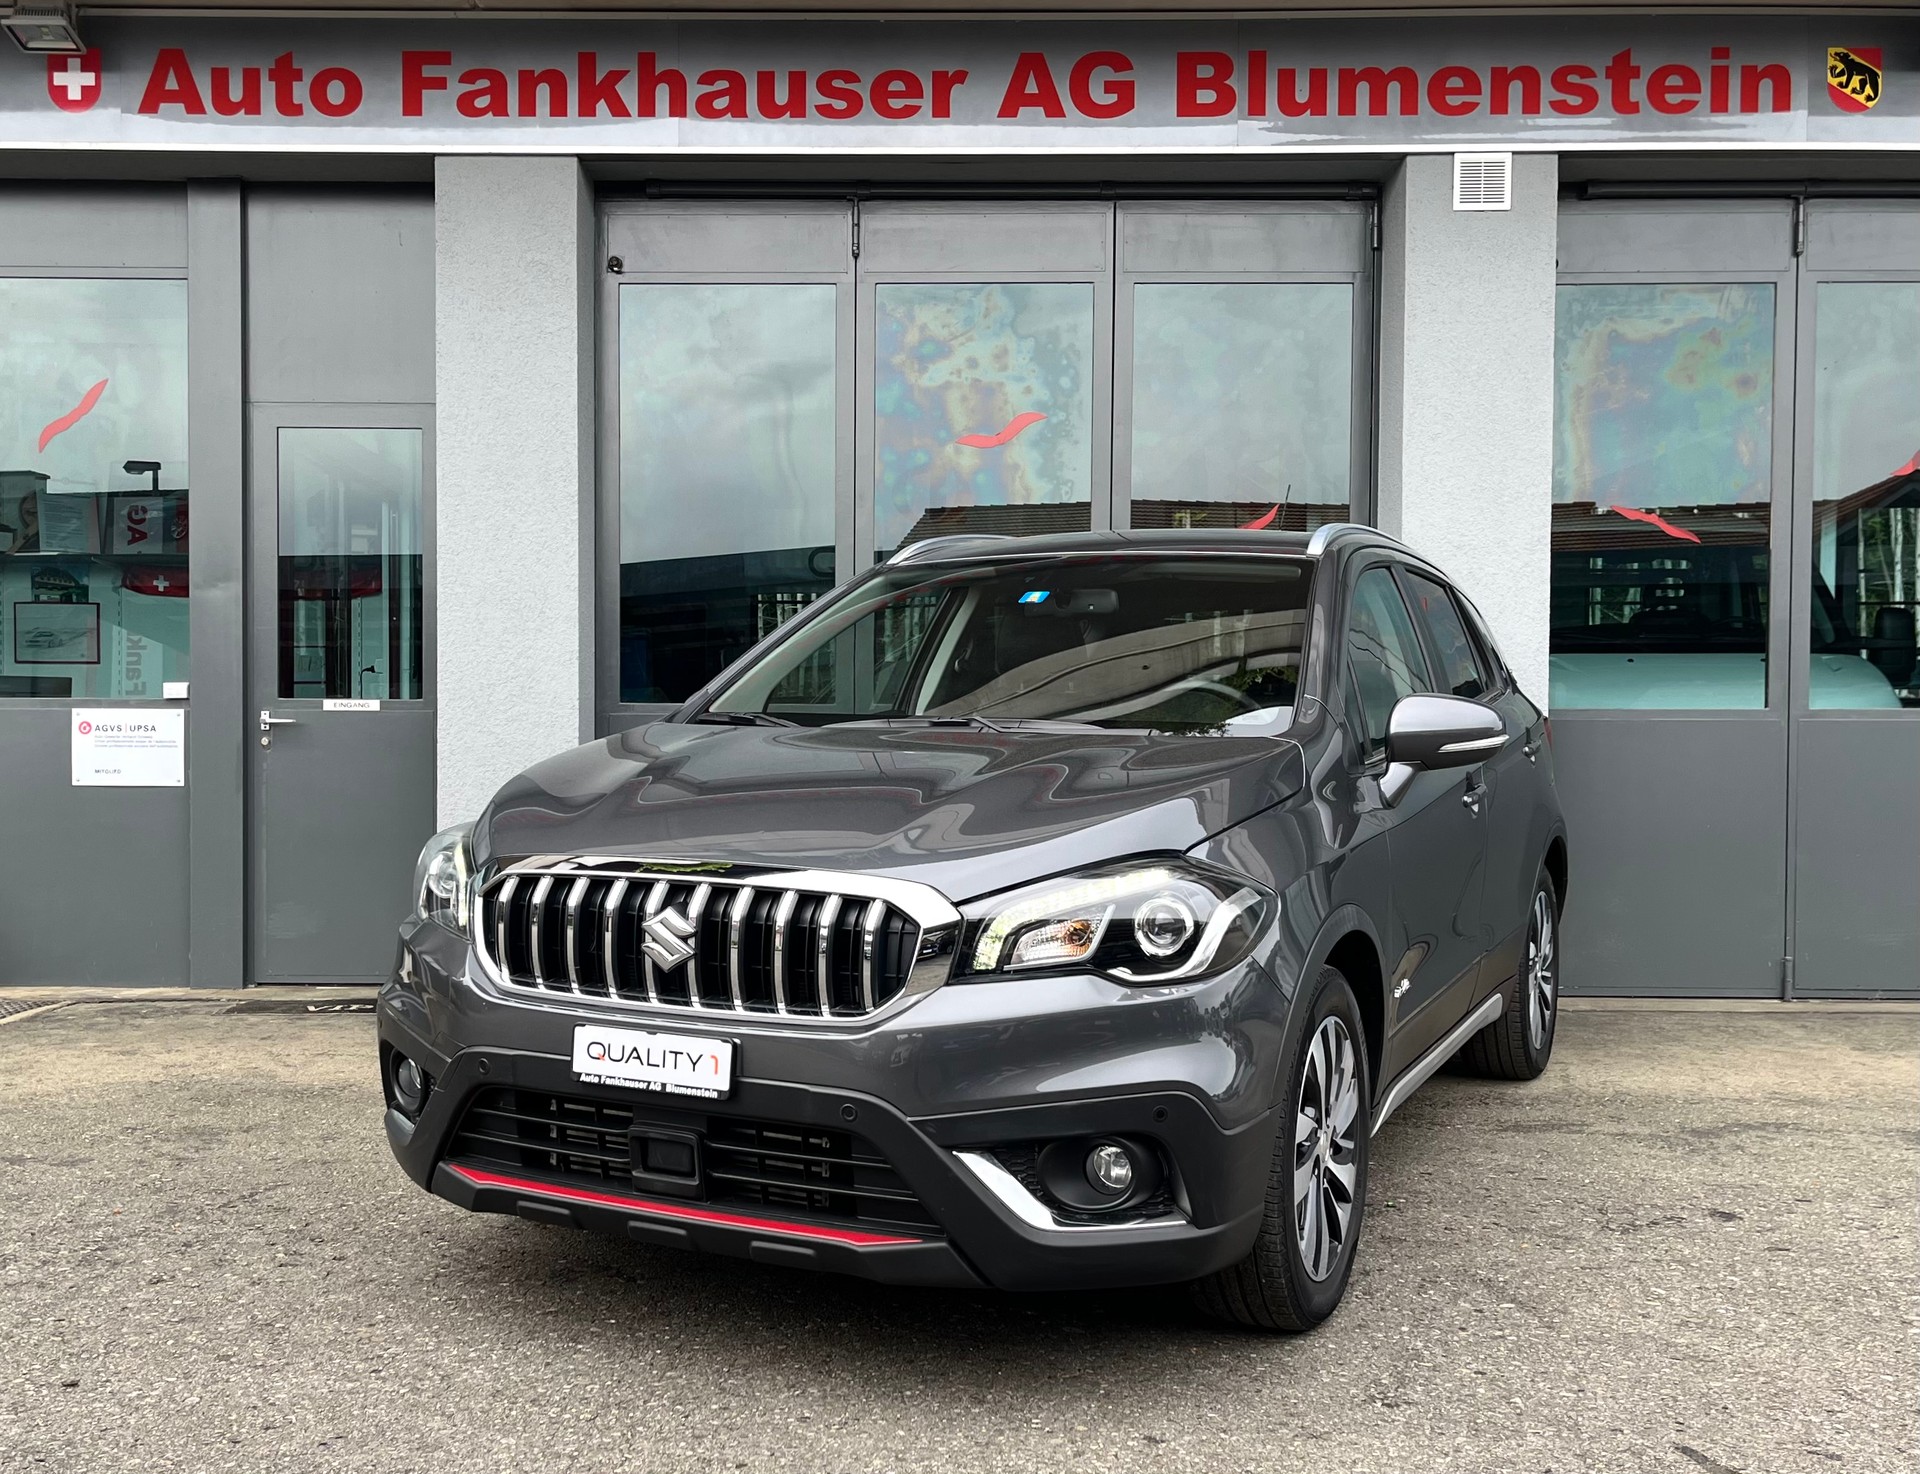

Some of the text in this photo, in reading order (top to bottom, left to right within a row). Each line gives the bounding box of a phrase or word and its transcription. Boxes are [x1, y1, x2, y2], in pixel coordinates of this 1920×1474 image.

[138, 47, 1792, 120] Auto Fankhauser AG Blumenstein
[94, 724, 157, 732] AGVS UPSA
[580, 1072, 718, 1099] Auto Fankhauser AG Blumenstein
